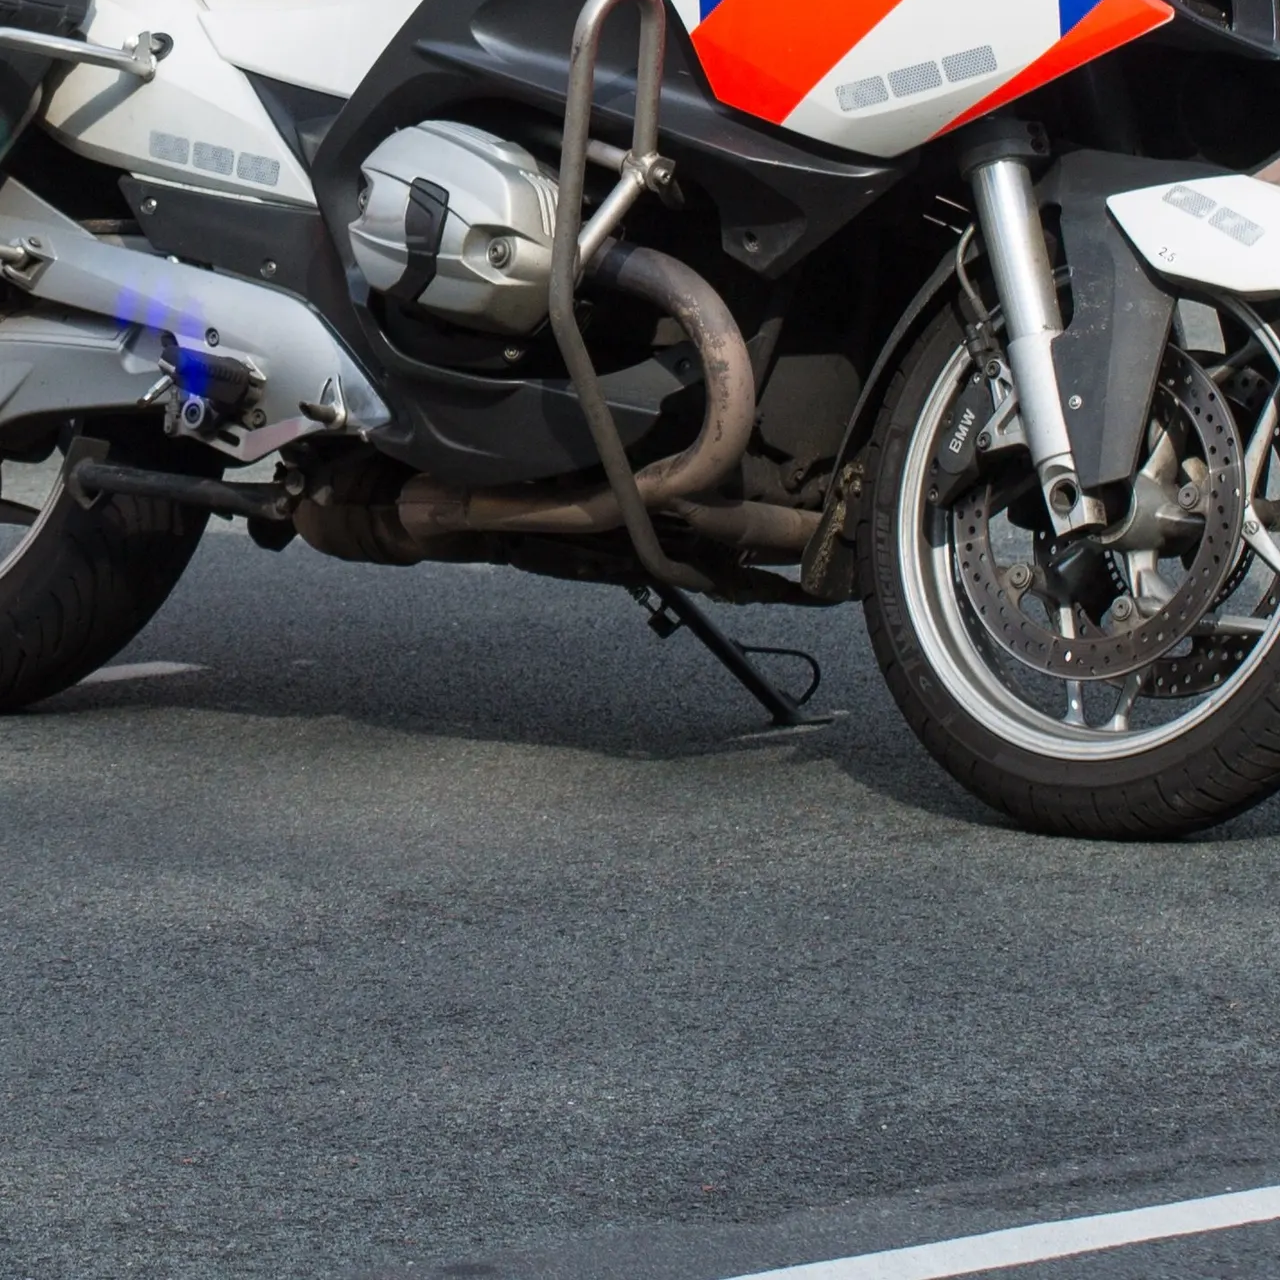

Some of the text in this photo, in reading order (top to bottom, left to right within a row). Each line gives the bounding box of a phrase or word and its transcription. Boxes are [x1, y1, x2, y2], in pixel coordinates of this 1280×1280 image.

[1158, 246, 1177, 262] 2.5
[948, 407, 976, 454] BMW
[876, 511, 902, 626] MICHELIN
